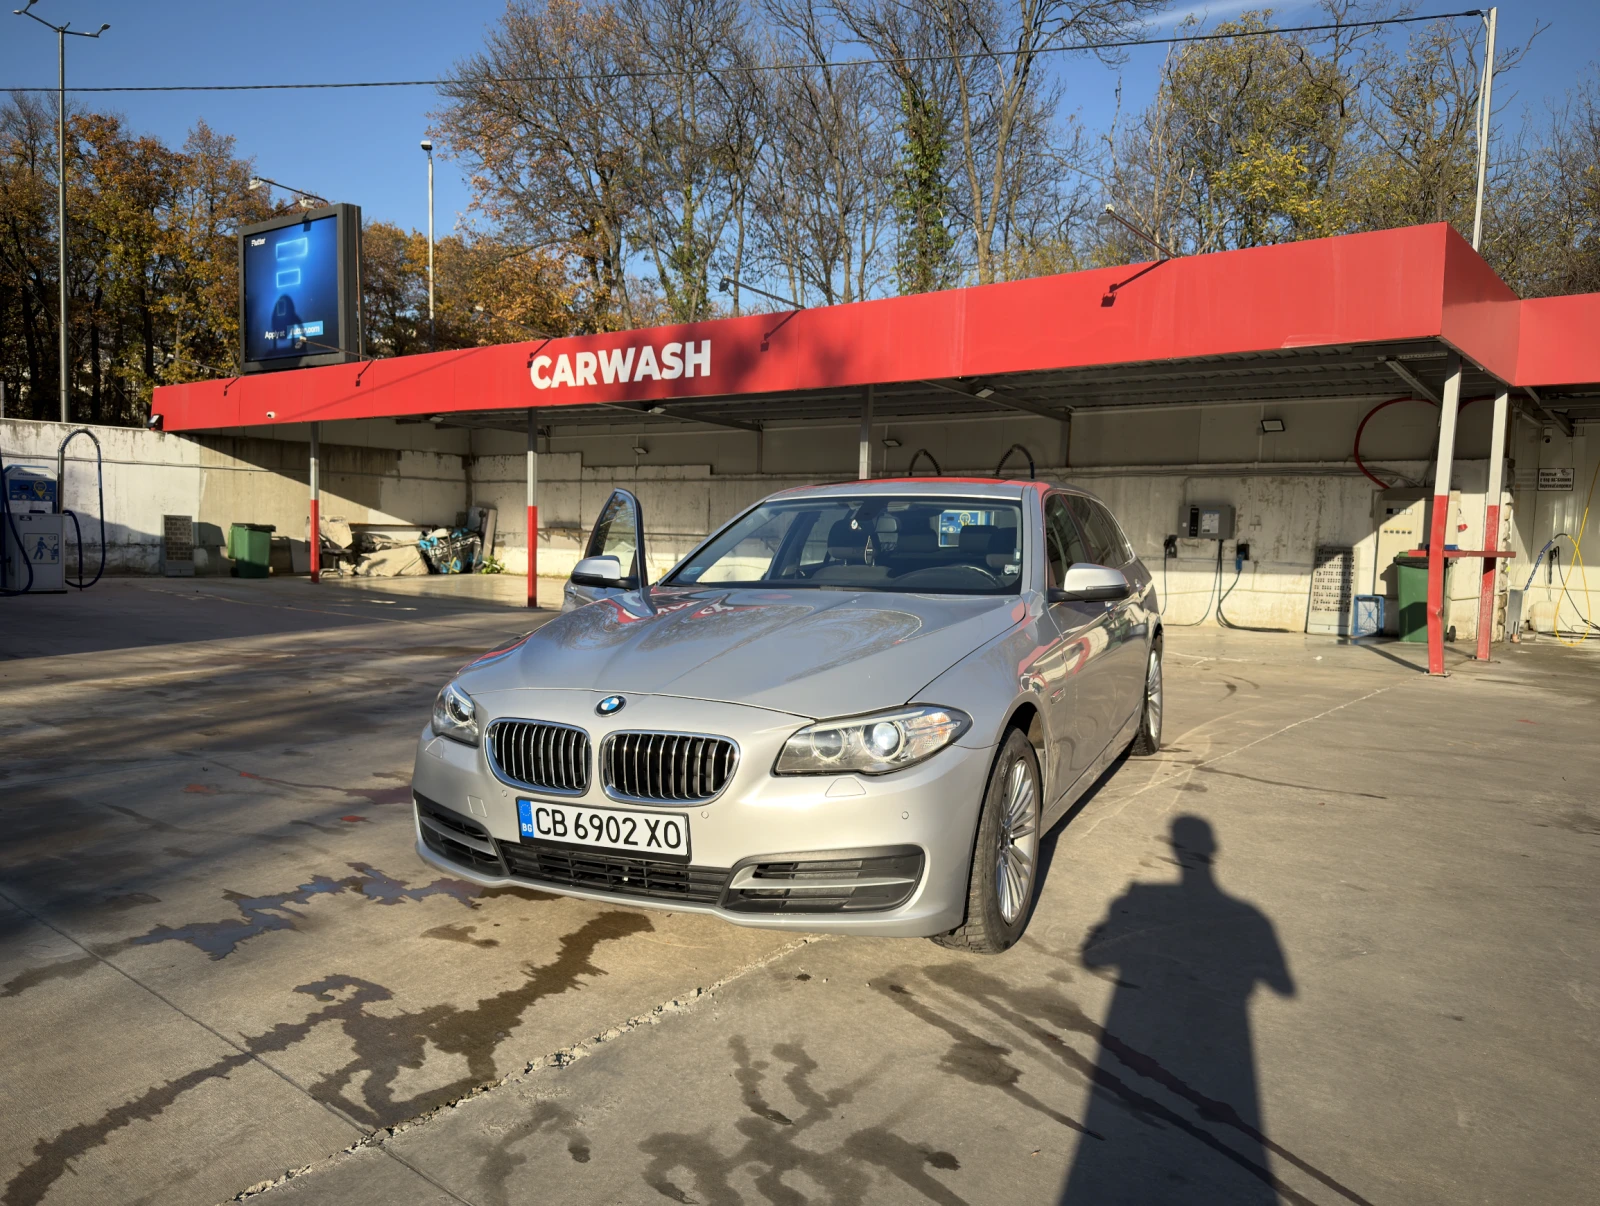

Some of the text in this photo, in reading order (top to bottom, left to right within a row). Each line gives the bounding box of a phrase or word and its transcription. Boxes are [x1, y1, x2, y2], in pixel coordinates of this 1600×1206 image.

[264, 329, 280, 340] Apply
[530, 340, 711, 390] CARWASH
[522, 823, 533, 833] BG
[535, 807, 568, 837] CB
[574, 812, 639, 846] 6902
